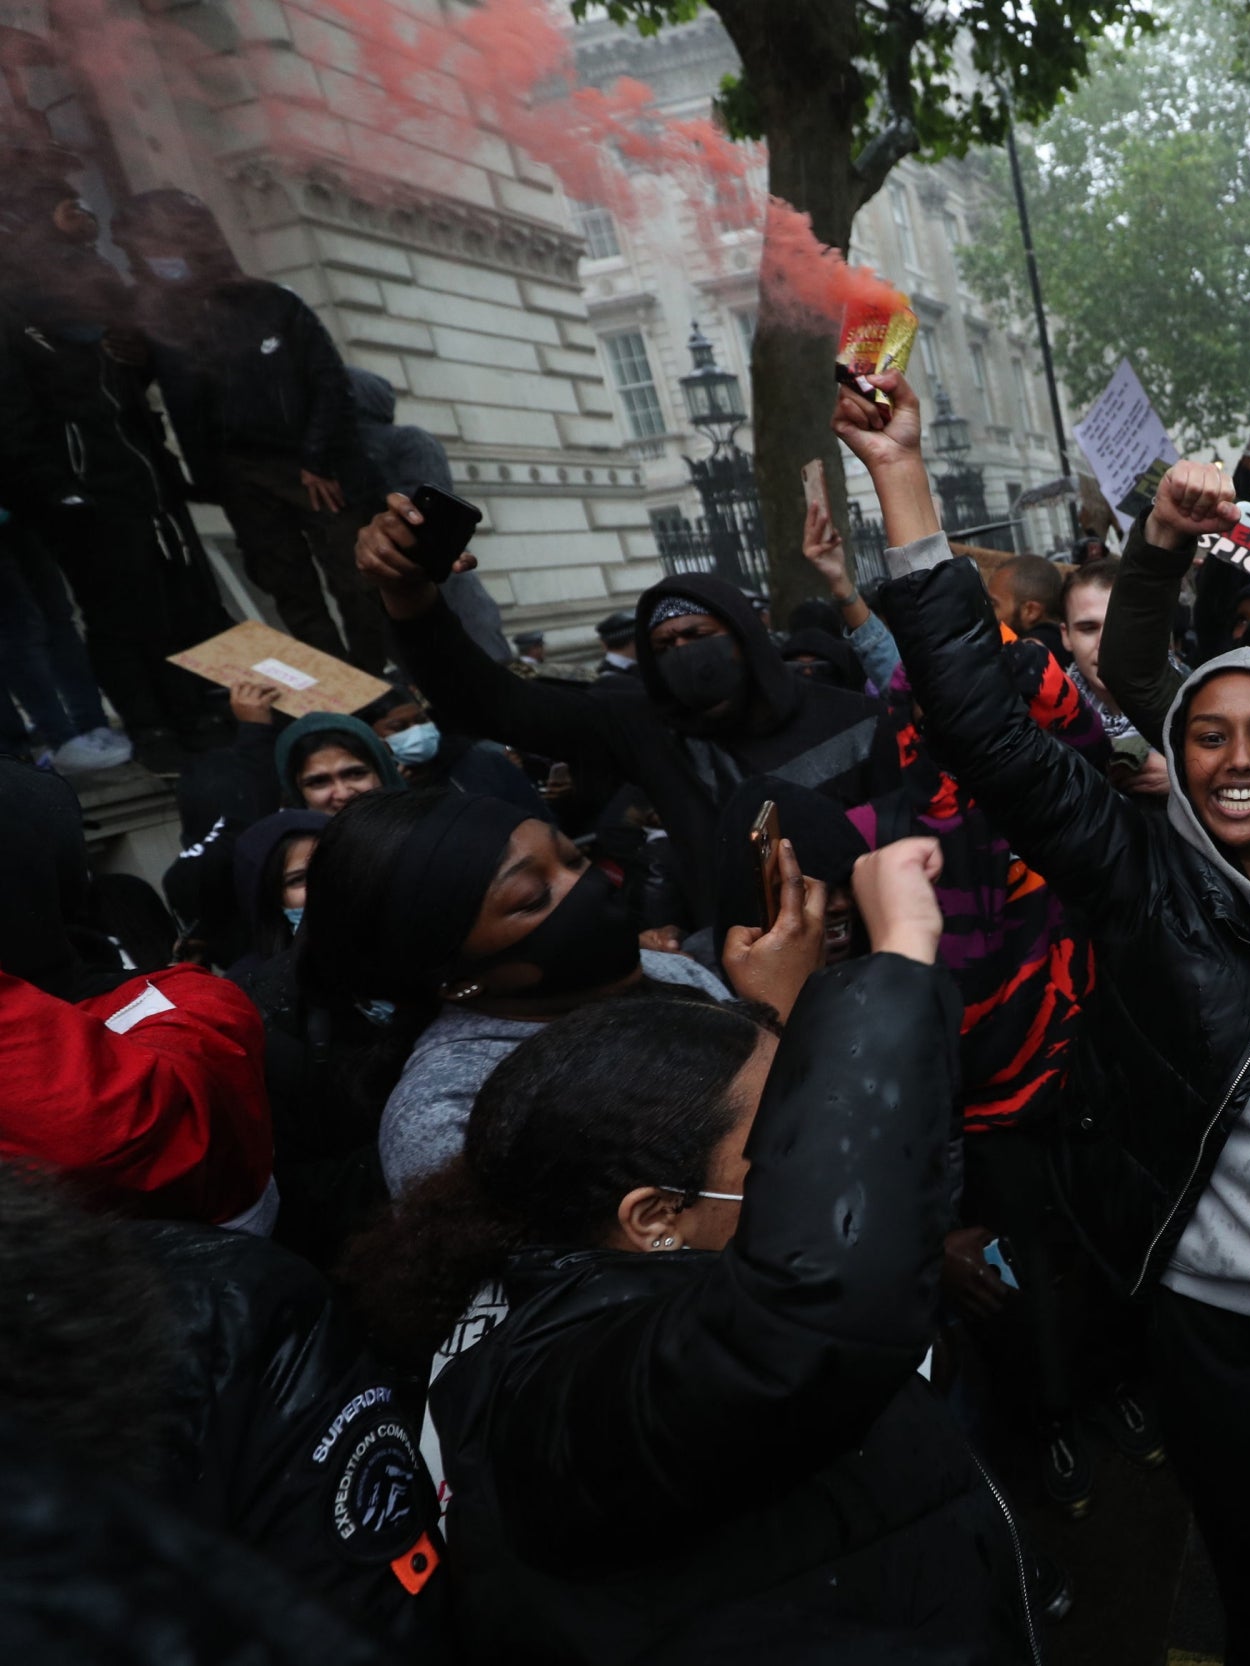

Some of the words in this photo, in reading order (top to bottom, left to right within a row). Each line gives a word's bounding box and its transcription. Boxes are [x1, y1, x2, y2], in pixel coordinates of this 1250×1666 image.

[312, 1386, 392, 1463] SUPERDRY
[334, 1431, 377, 1540] EXPEDITION
[377, 1423, 419, 1470] COMPANY
